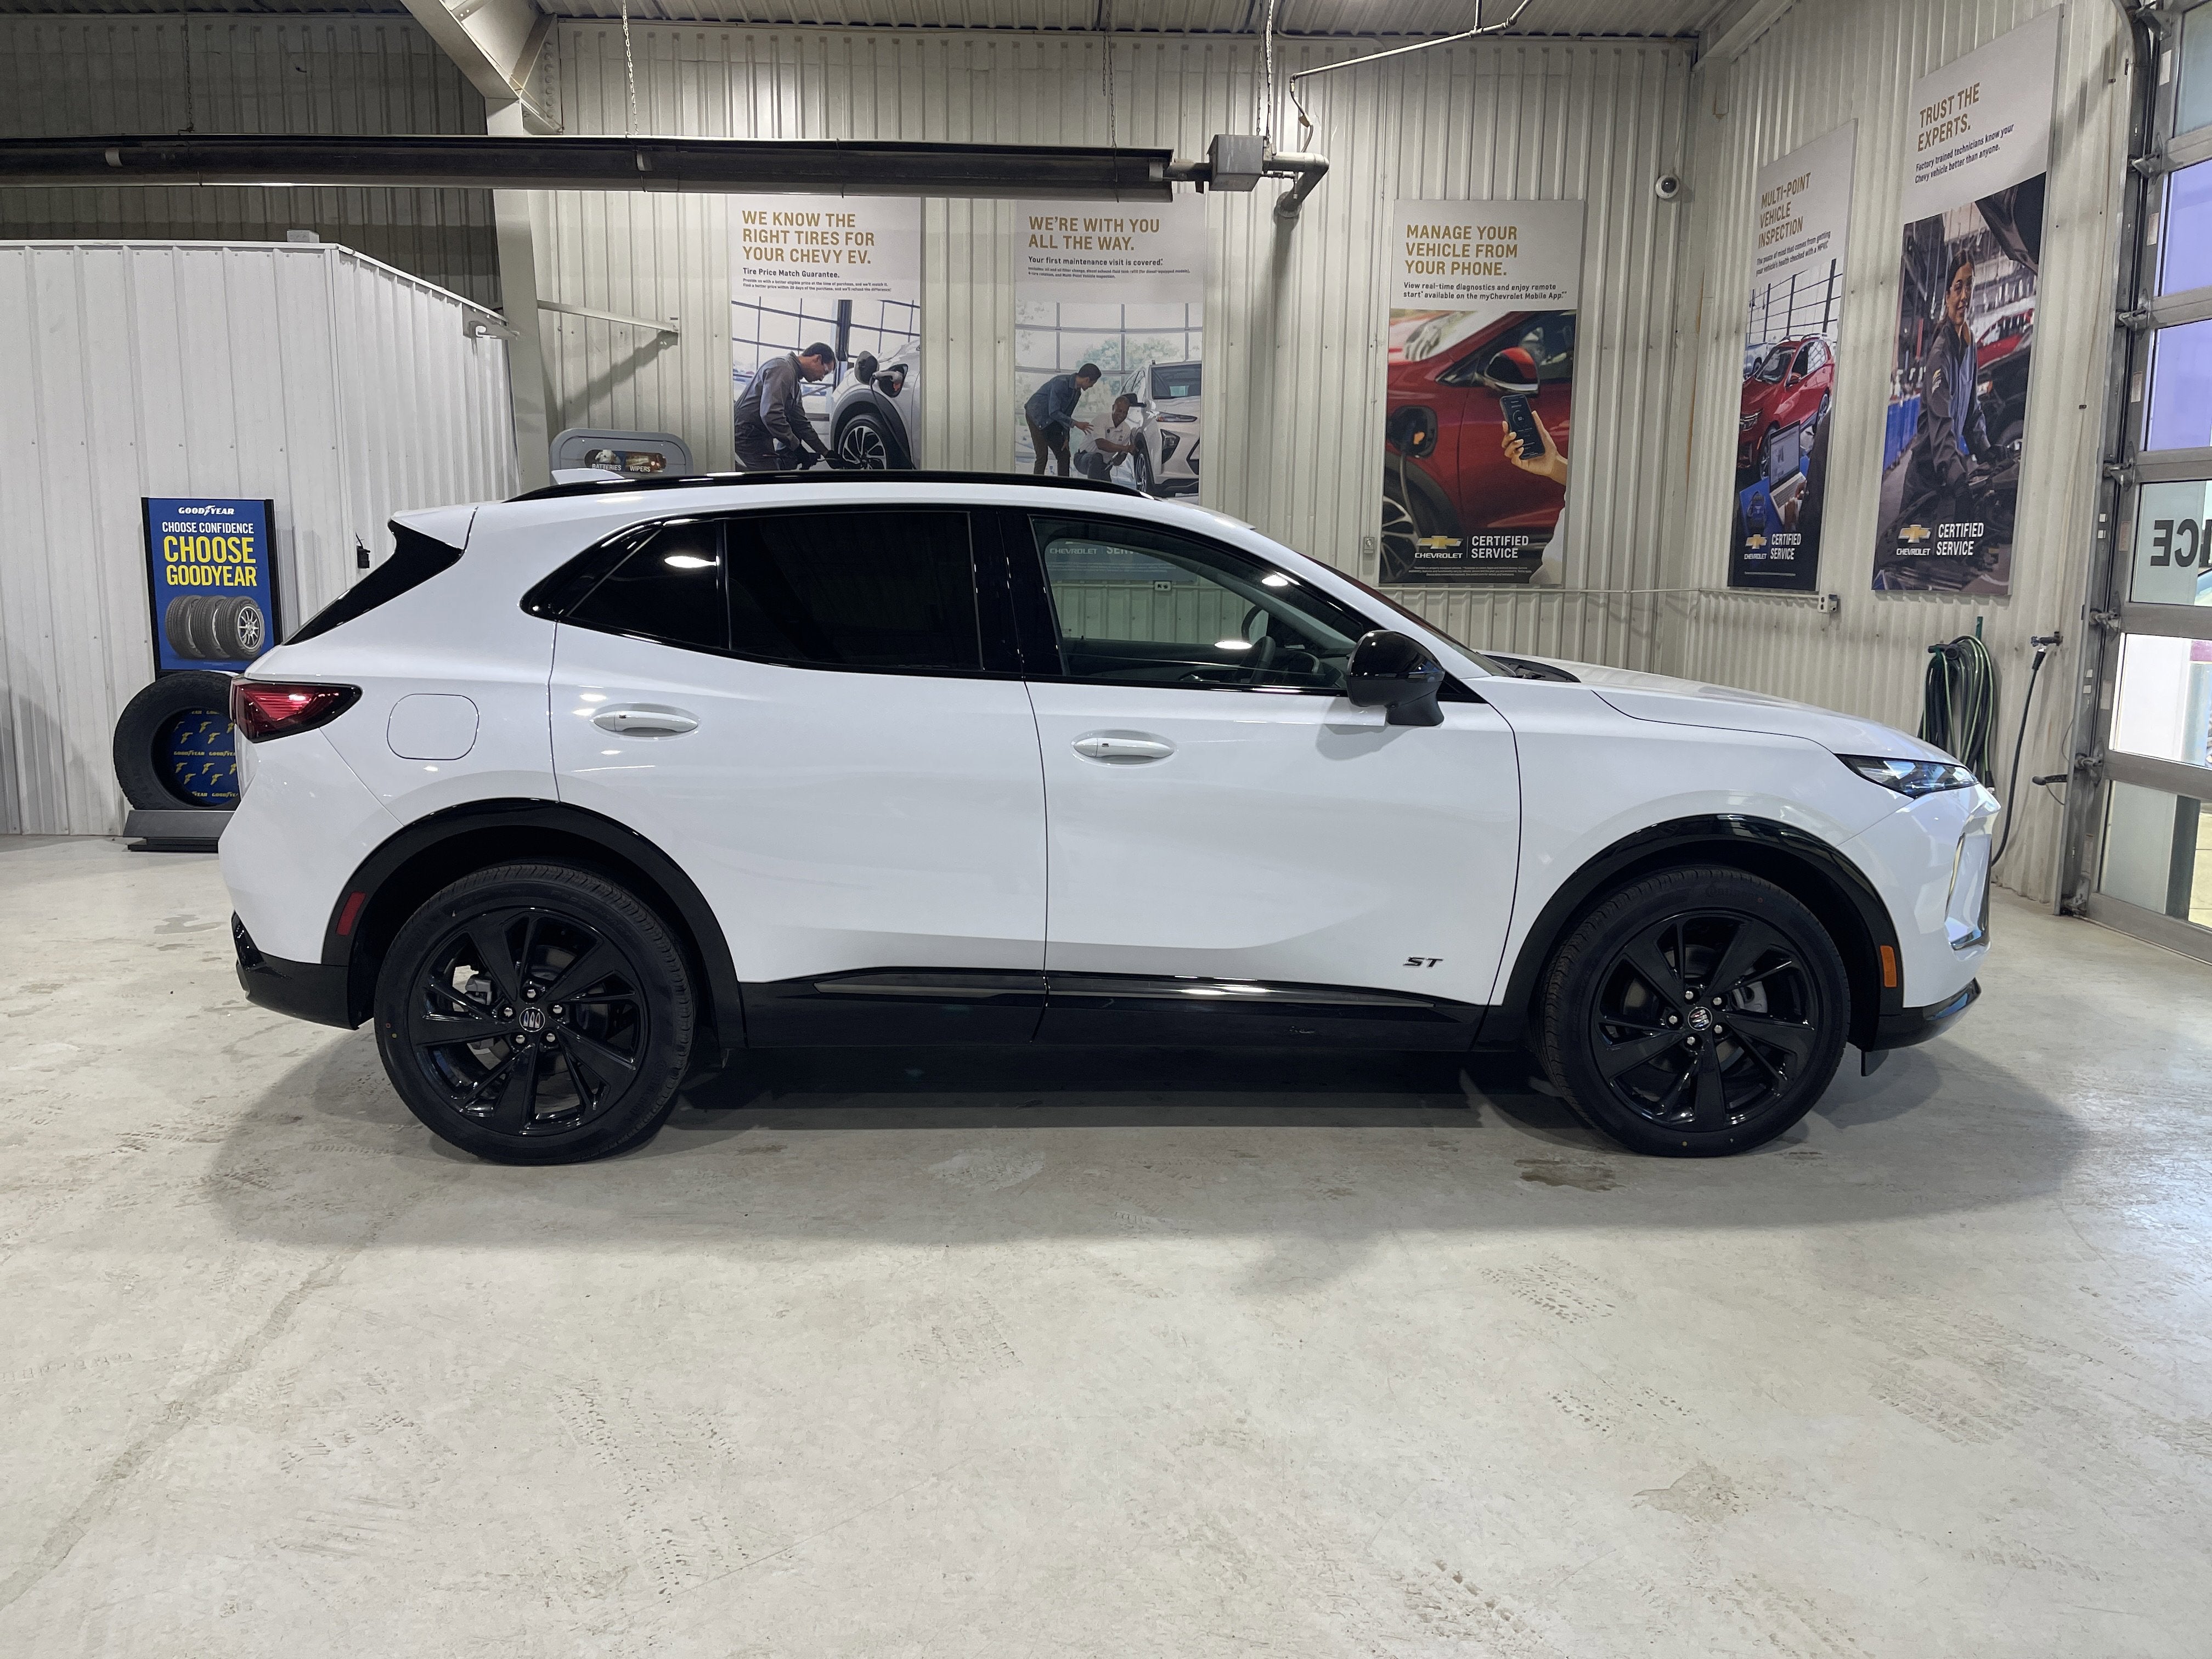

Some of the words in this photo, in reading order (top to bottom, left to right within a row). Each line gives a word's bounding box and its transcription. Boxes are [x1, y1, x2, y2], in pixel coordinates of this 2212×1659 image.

[1920, 95, 1955, 128] TRUST
[1957, 82, 1980, 110] THE
[1917, 113, 1971, 152] EXPERTS.
[1916, 158, 1934, 172] Factory
[1936, 149, 1953, 163] trained
[1954, 137, 1984, 156] technicians
[1985, 129, 2000, 143] know
[2000, 123, 2015, 139] your
[1915, 173, 1929, 184] Chevy
[1931, 163, 1948, 178] vehicle
[1949, 158, 1965, 171] better
[1966, 153, 1978, 163] than
[1979, 143, 2000, 159] anyone.
[1761, 172, 1811, 209] MULTI-POINT
[742, 210, 767, 225] WE
[773, 212, 821, 227] KNOW
[826, 213, 856, 228] THE
[1759, 201, 1791, 228] VEHICLE
[1029, 216, 1078, 232] WE'RE
[1083, 218, 1124, 233] WITH
[1128, 219, 1160, 233] YOU
[1407, 225, 1472, 240] MANAGE
[1477, 225, 1517, 240] YOUR
[1758, 216, 1803, 249] INSPECTION
[743, 228, 789, 243] RIGHT
[794, 230, 839, 246] TIRES
[845, 232, 874, 246] FOR
[1029, 234, 1058, 249] ALL
[1063, 235, 1092, 250] THE
[1097, 236, 1134, 251] WAY.
[742, 246, 784, 262] YOUR
[790, 248, 843, 263] CHEVY
[848, 250, 871, 264] EV.
[1406, 242, 1471, 257] VEHICLE
[1475, 244, 1517, 258] FROM
[1405, 260, 1445, 275] YOUR
[1451, 261, 1507, 276] PHONE.
[1456, 283, 1495, 292] diagnostics
[1511, 284, 1530, 292] enjoy
[1480, 293, 1523, 301] myChevrolet
[178, 505, 235, 516] GOODYEAR
[162, 522, 197, 533] CHOOSE
[199, 522, 254, 534] CONFIDENCE
[1938, 522, 1984, 538] CERTIFIED
[1471, 535, 1529, 546] CERTIFIED
[1771, 533, 1802, 545] CERTIFIED
[164, 535, 256, 563] CHOOSE
[1471, 548, 1518, 559] SERVICE
[1770, 548, 1795, 560] SERVICE
[1936, 540, 1974, 556] SERVICE
[166, 565, 257, 586] GOODYEAR
[1403, 957, 1444, 968] ST
